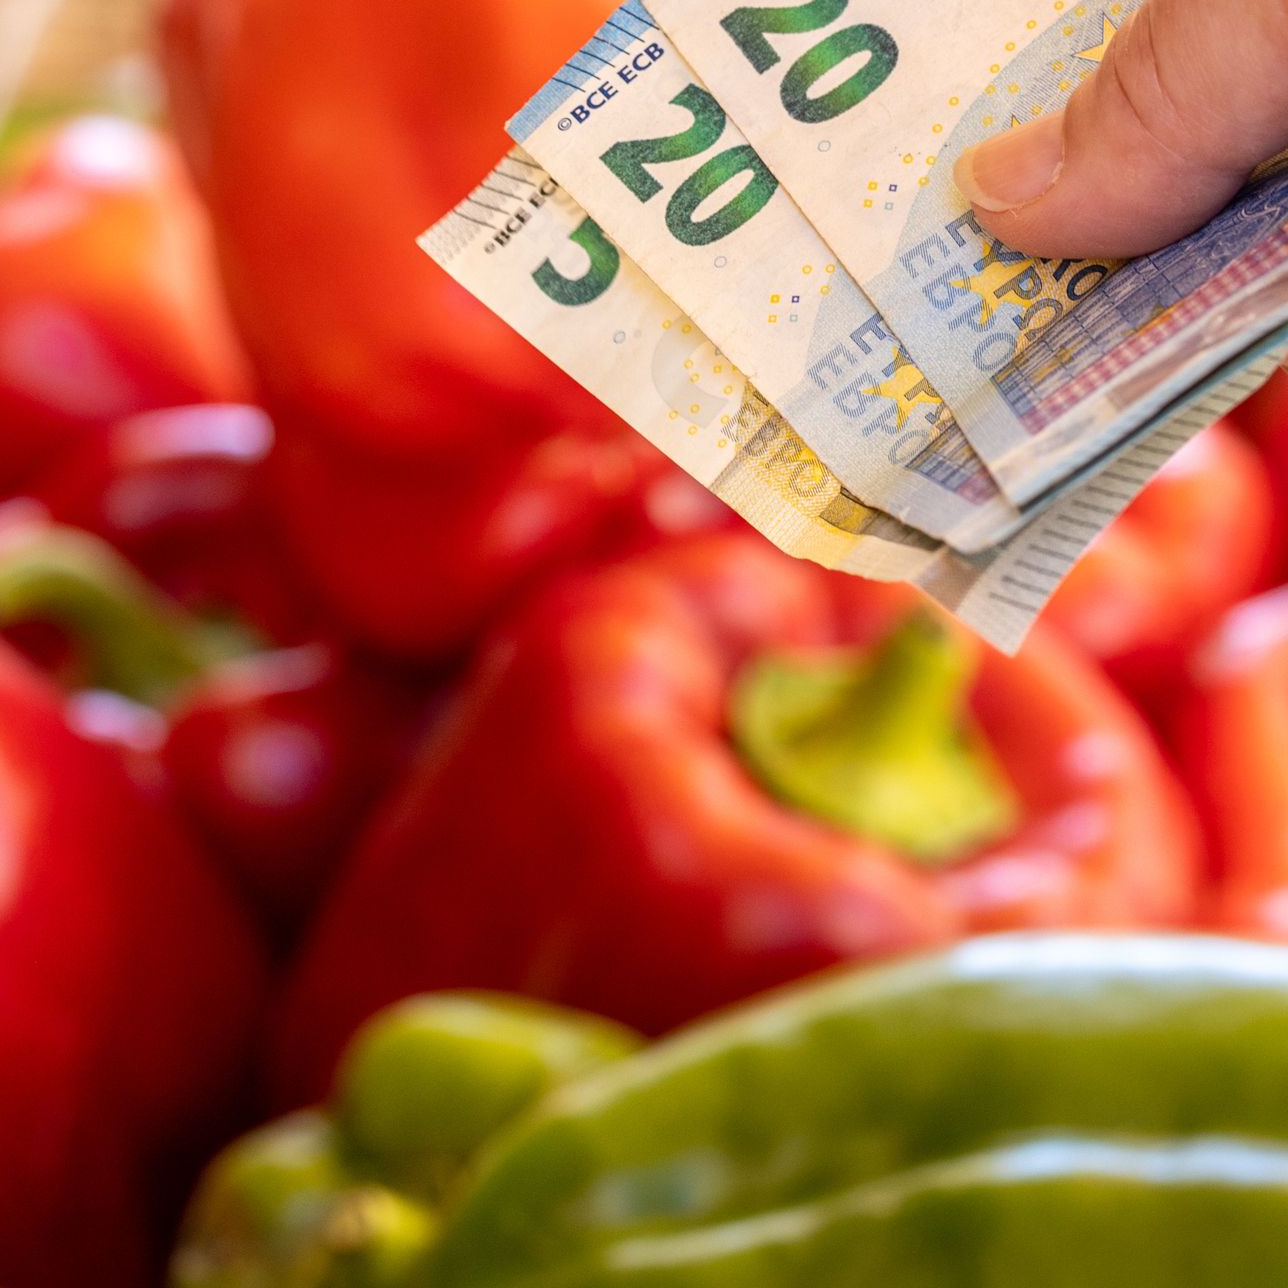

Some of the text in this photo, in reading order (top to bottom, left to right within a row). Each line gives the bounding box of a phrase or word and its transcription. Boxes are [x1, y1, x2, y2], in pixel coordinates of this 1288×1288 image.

[616, 42, 665, 85] ECB
[598, 82, 780, 247] 20
[528, 177, 559, 210] EC
